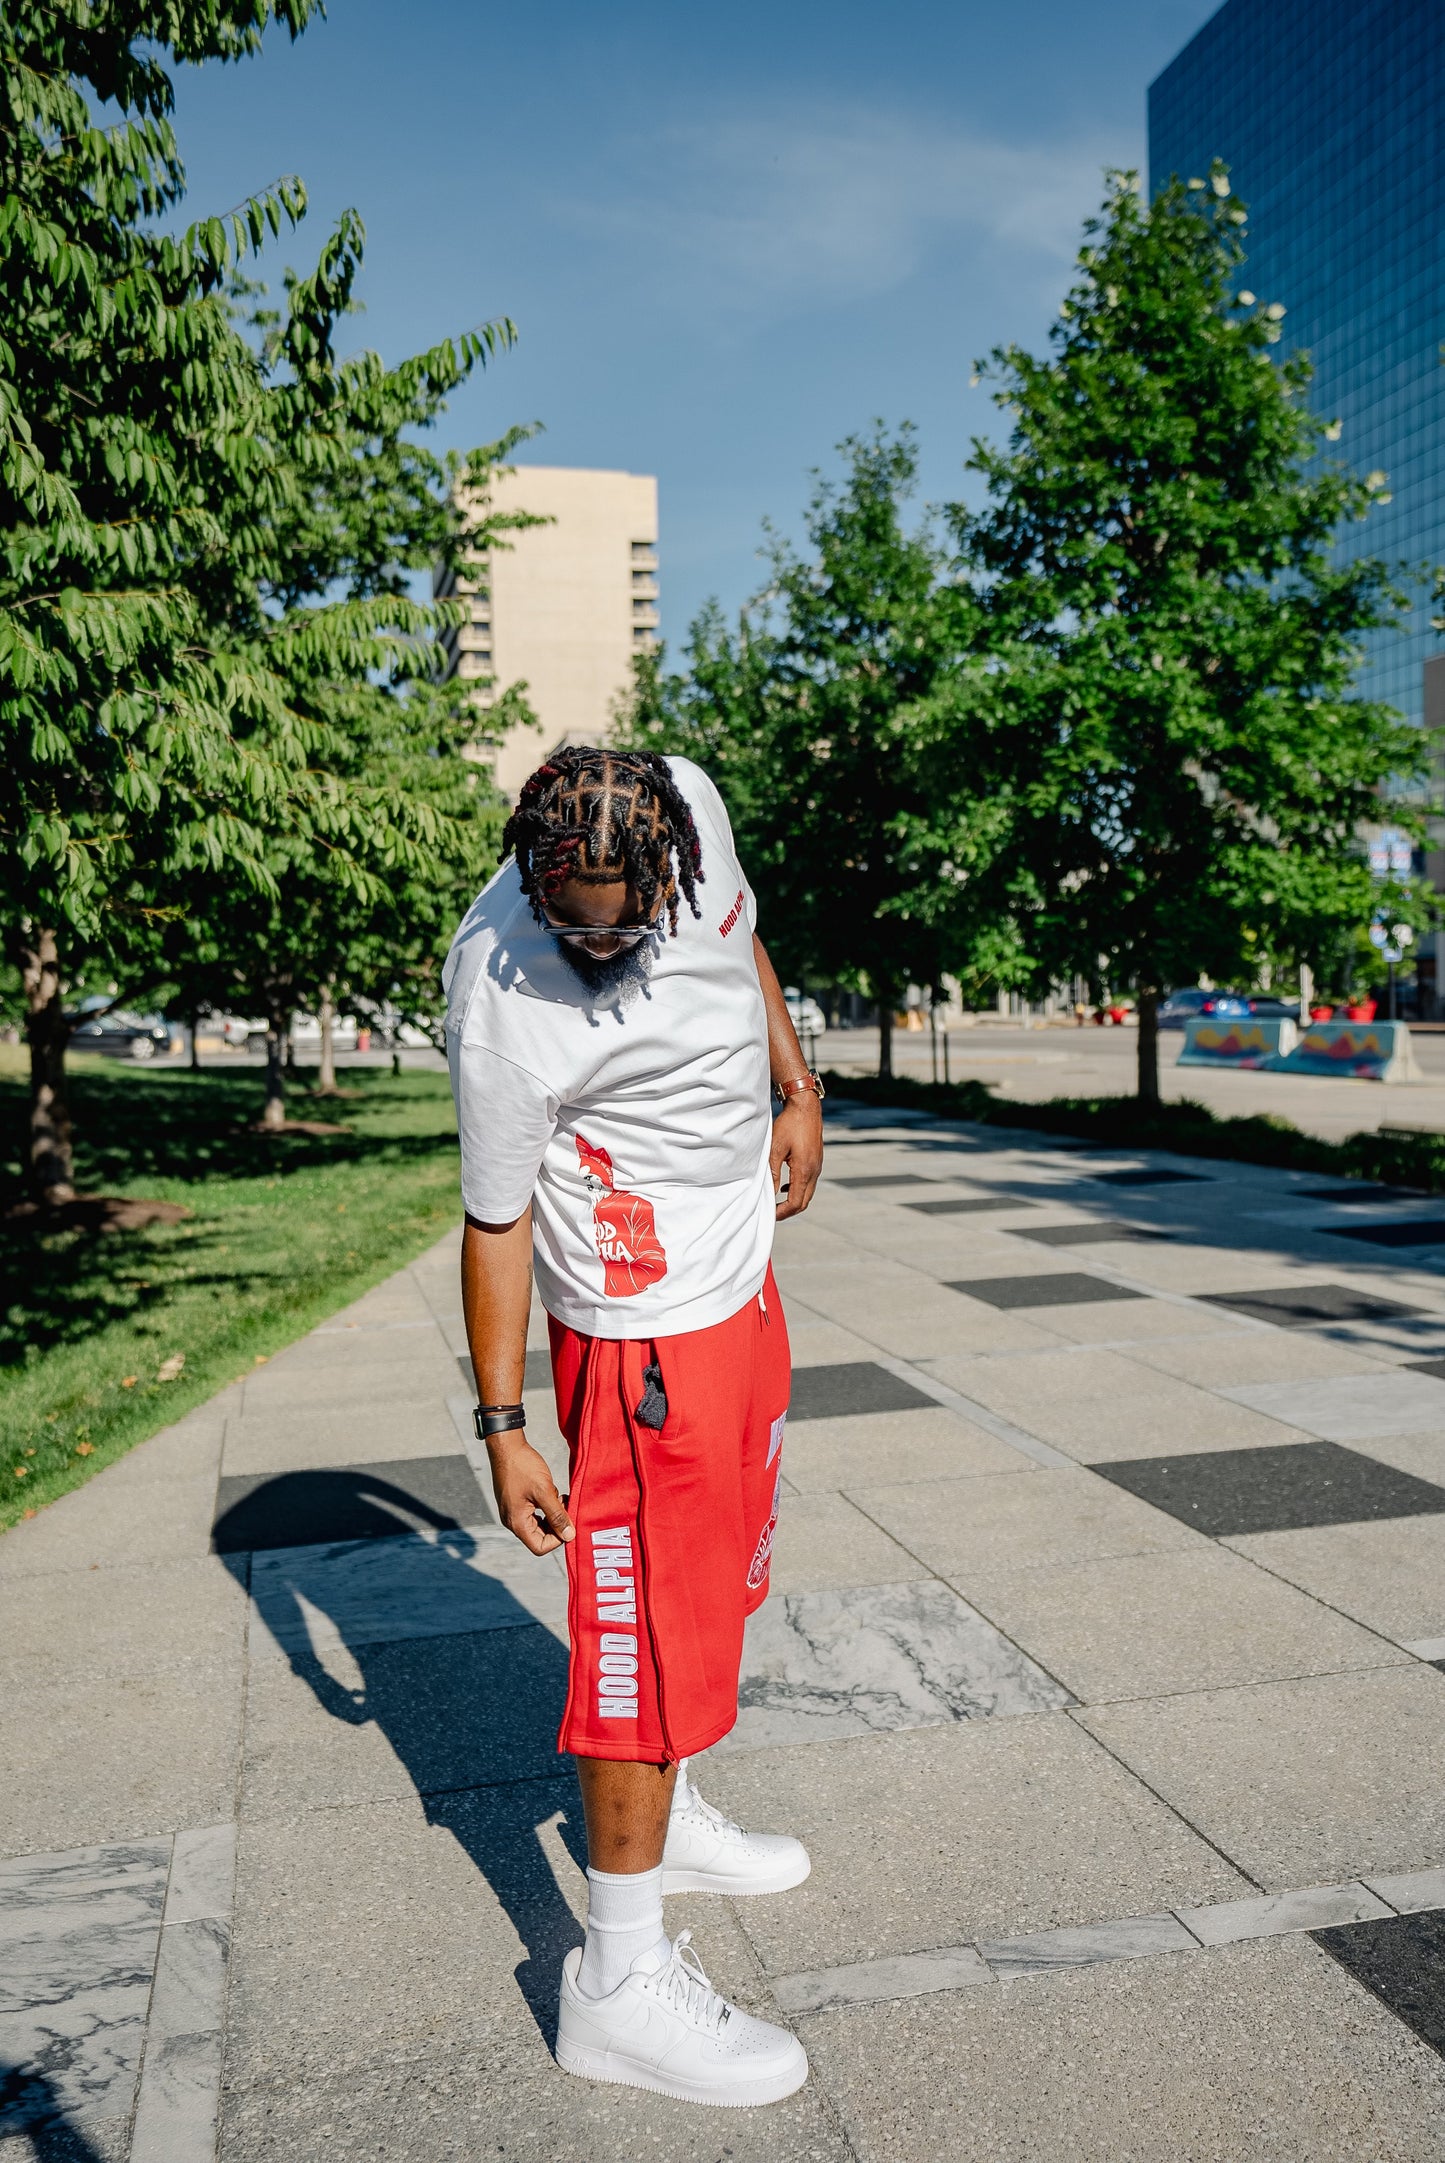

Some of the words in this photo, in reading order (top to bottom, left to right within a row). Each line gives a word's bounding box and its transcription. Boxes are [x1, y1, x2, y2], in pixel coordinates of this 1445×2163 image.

[719, 909, 738, 938] HOOD
[591, 1525, 637, 1625] ALPHA
[597, 1632, 639, 1719] HOOD
[572, 2056, 590, 2069] AIR
